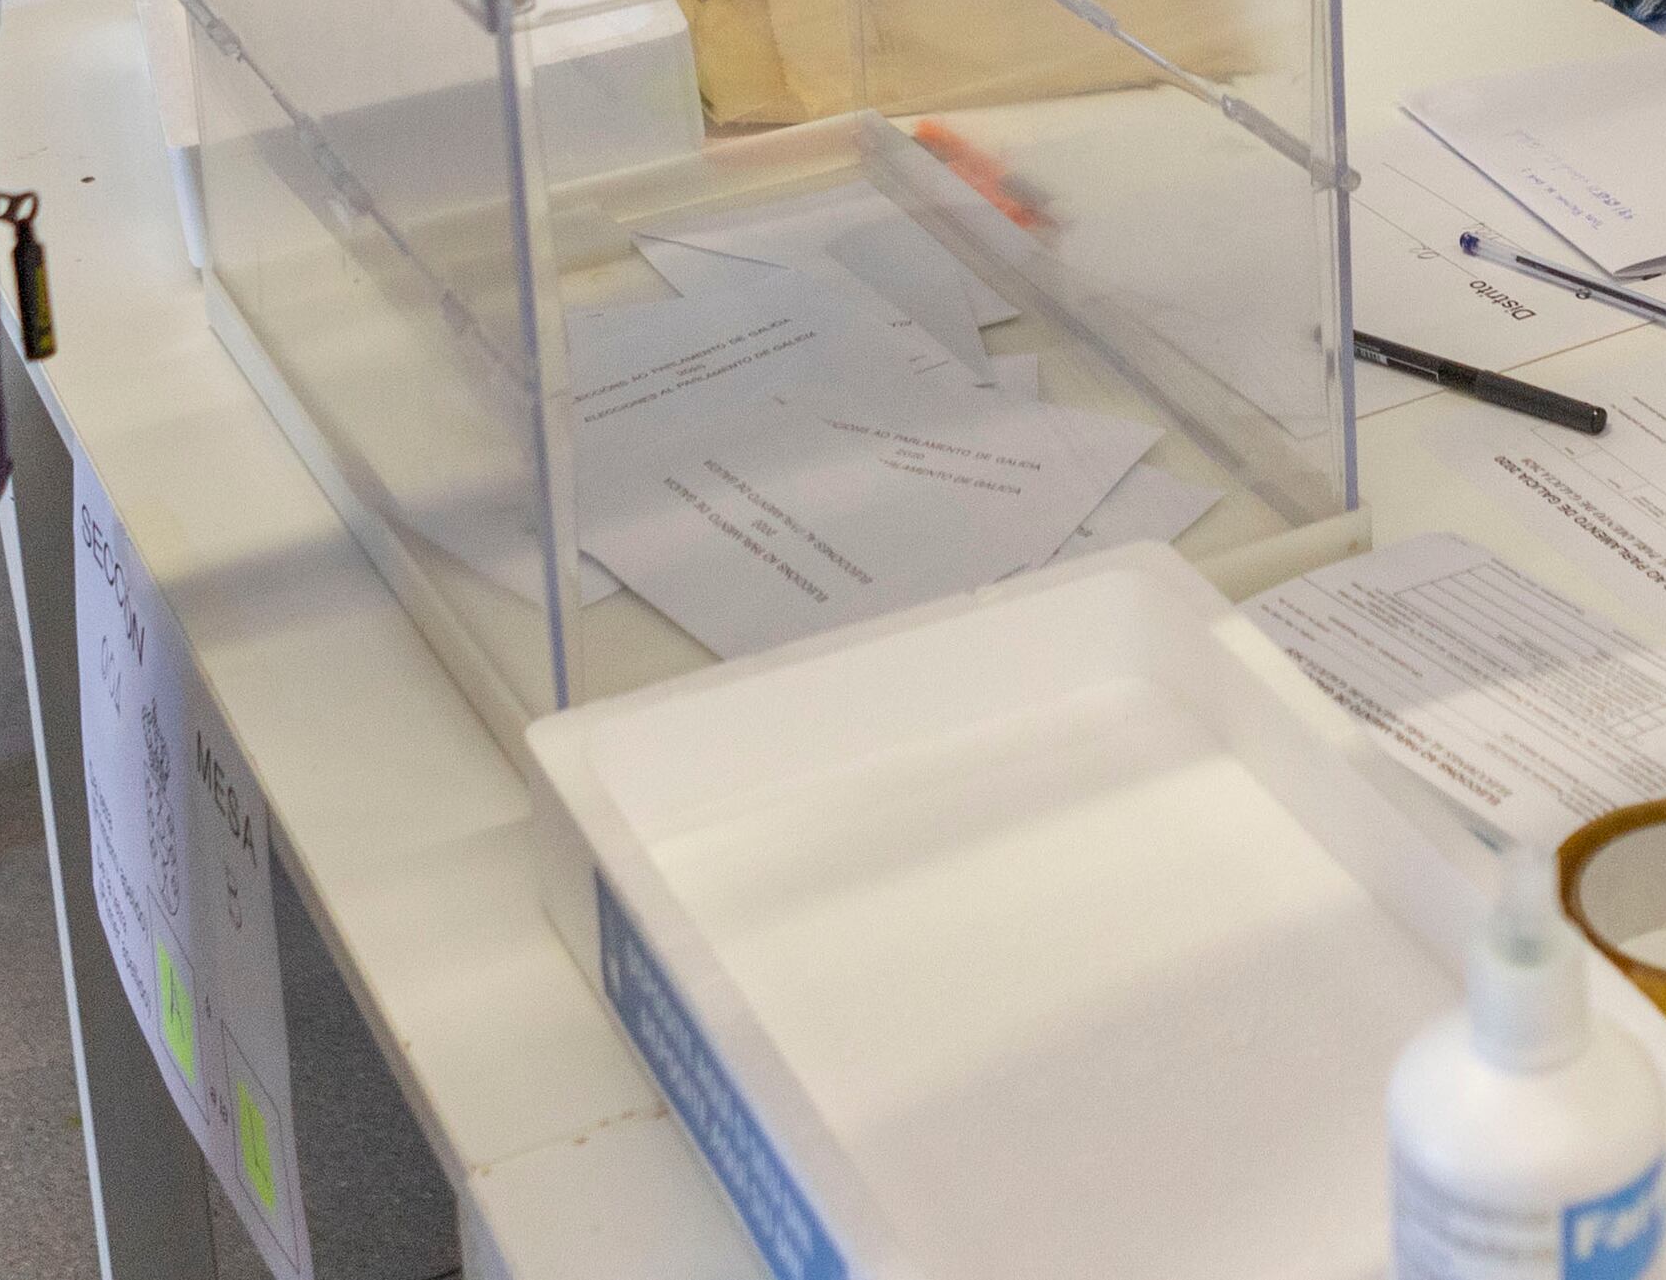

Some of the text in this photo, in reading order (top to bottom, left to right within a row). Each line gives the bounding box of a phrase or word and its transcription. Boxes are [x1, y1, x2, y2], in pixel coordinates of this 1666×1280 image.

[1470, 280, 1537, 321] Distrito
[1517, 470, 1562, 506] GALICIA
[1557, 502, 1577, 518] DE
[1573, 515, 1650, 572] PARLAMENTO
[1646, 569, 1666, 584] AO
[197, 728, 258, 869] MESA
